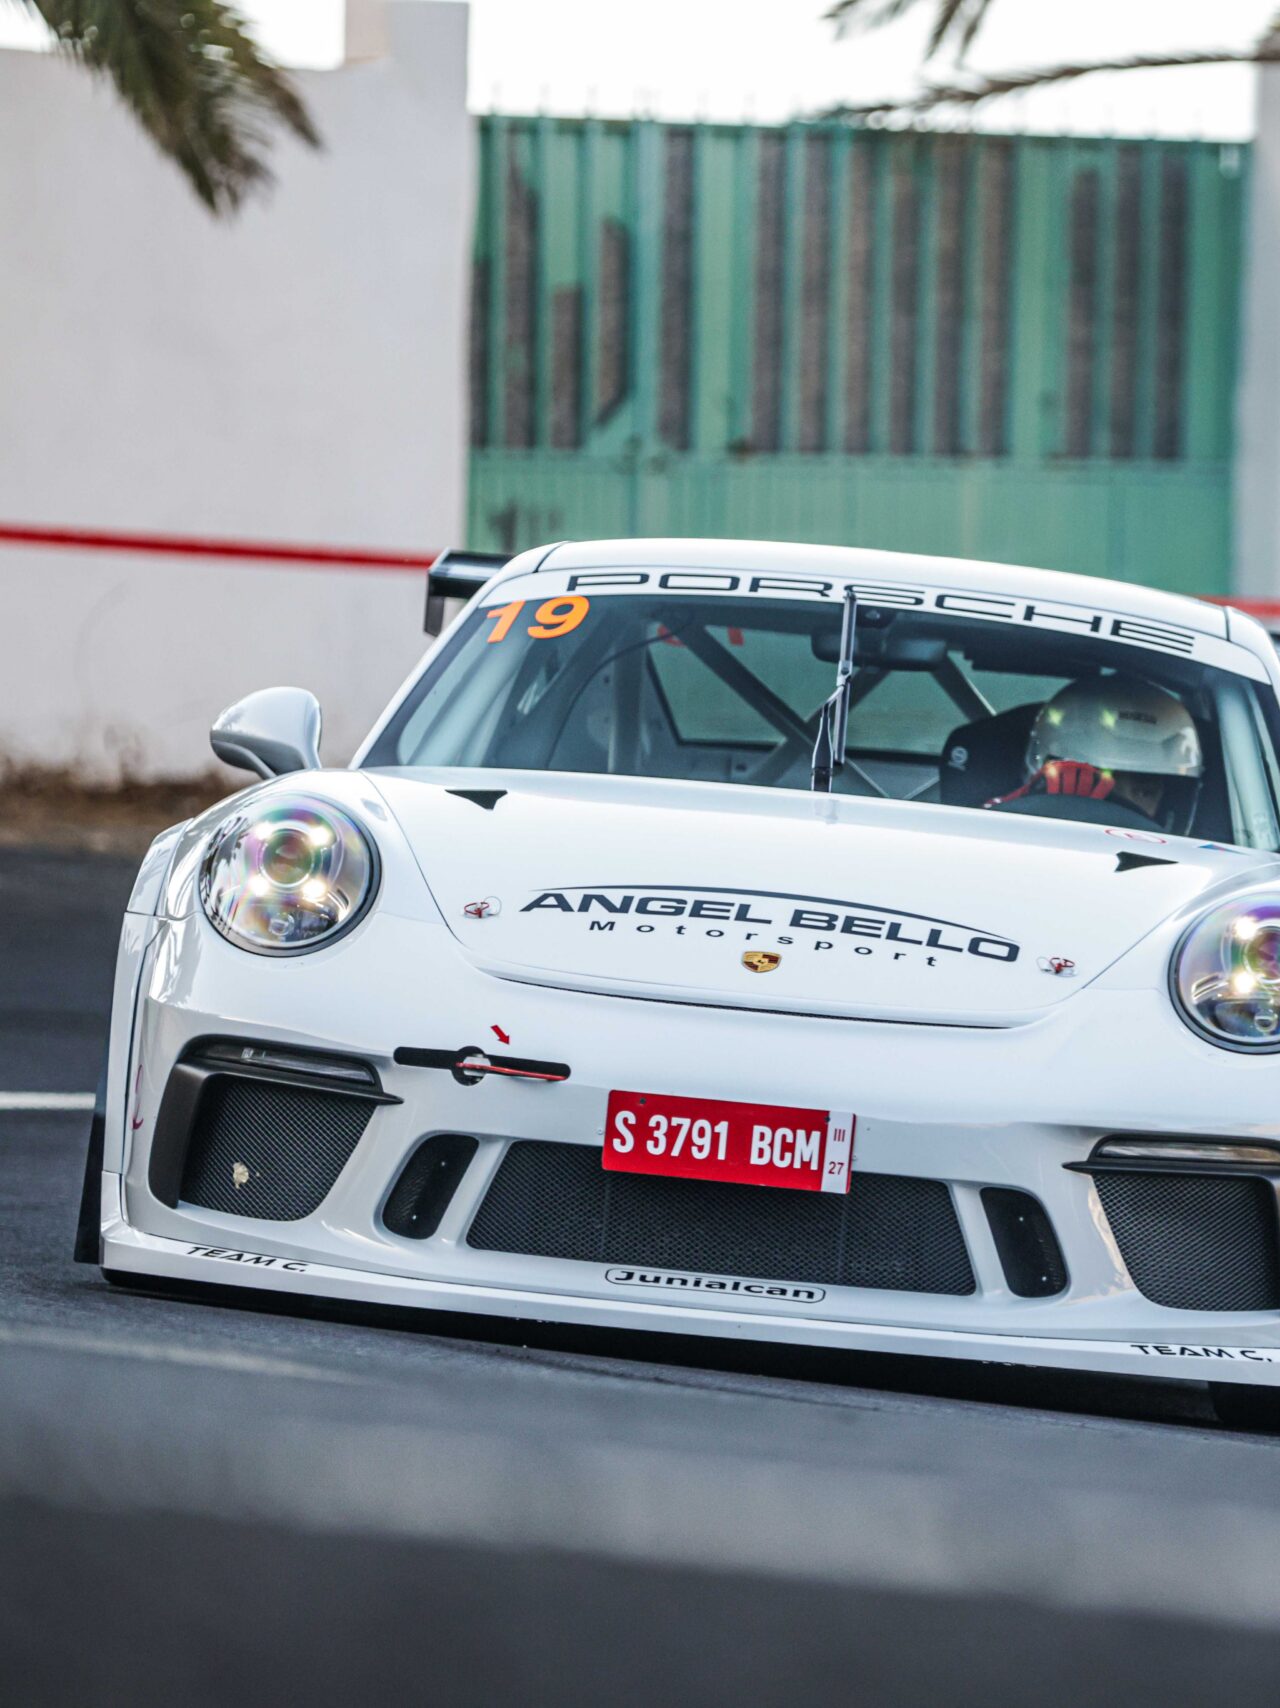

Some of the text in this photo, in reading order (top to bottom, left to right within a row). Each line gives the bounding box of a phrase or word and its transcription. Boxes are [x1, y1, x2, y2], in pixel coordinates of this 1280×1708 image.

[487, 595, 590, 643] 19
[567, 573, 1195, 655] PORSCHE
[520, 892, 1021, 964] ANGEL BELLO
[588, 920, 938, 966] Motorsport
[612, 1110, 821, 1171] S 3791 BCM
[828, 1161, 845, 1175] 27
[187, 1246, 276, 1266] TEAM
[1130, 1344, 1234, 1359] TEAM
